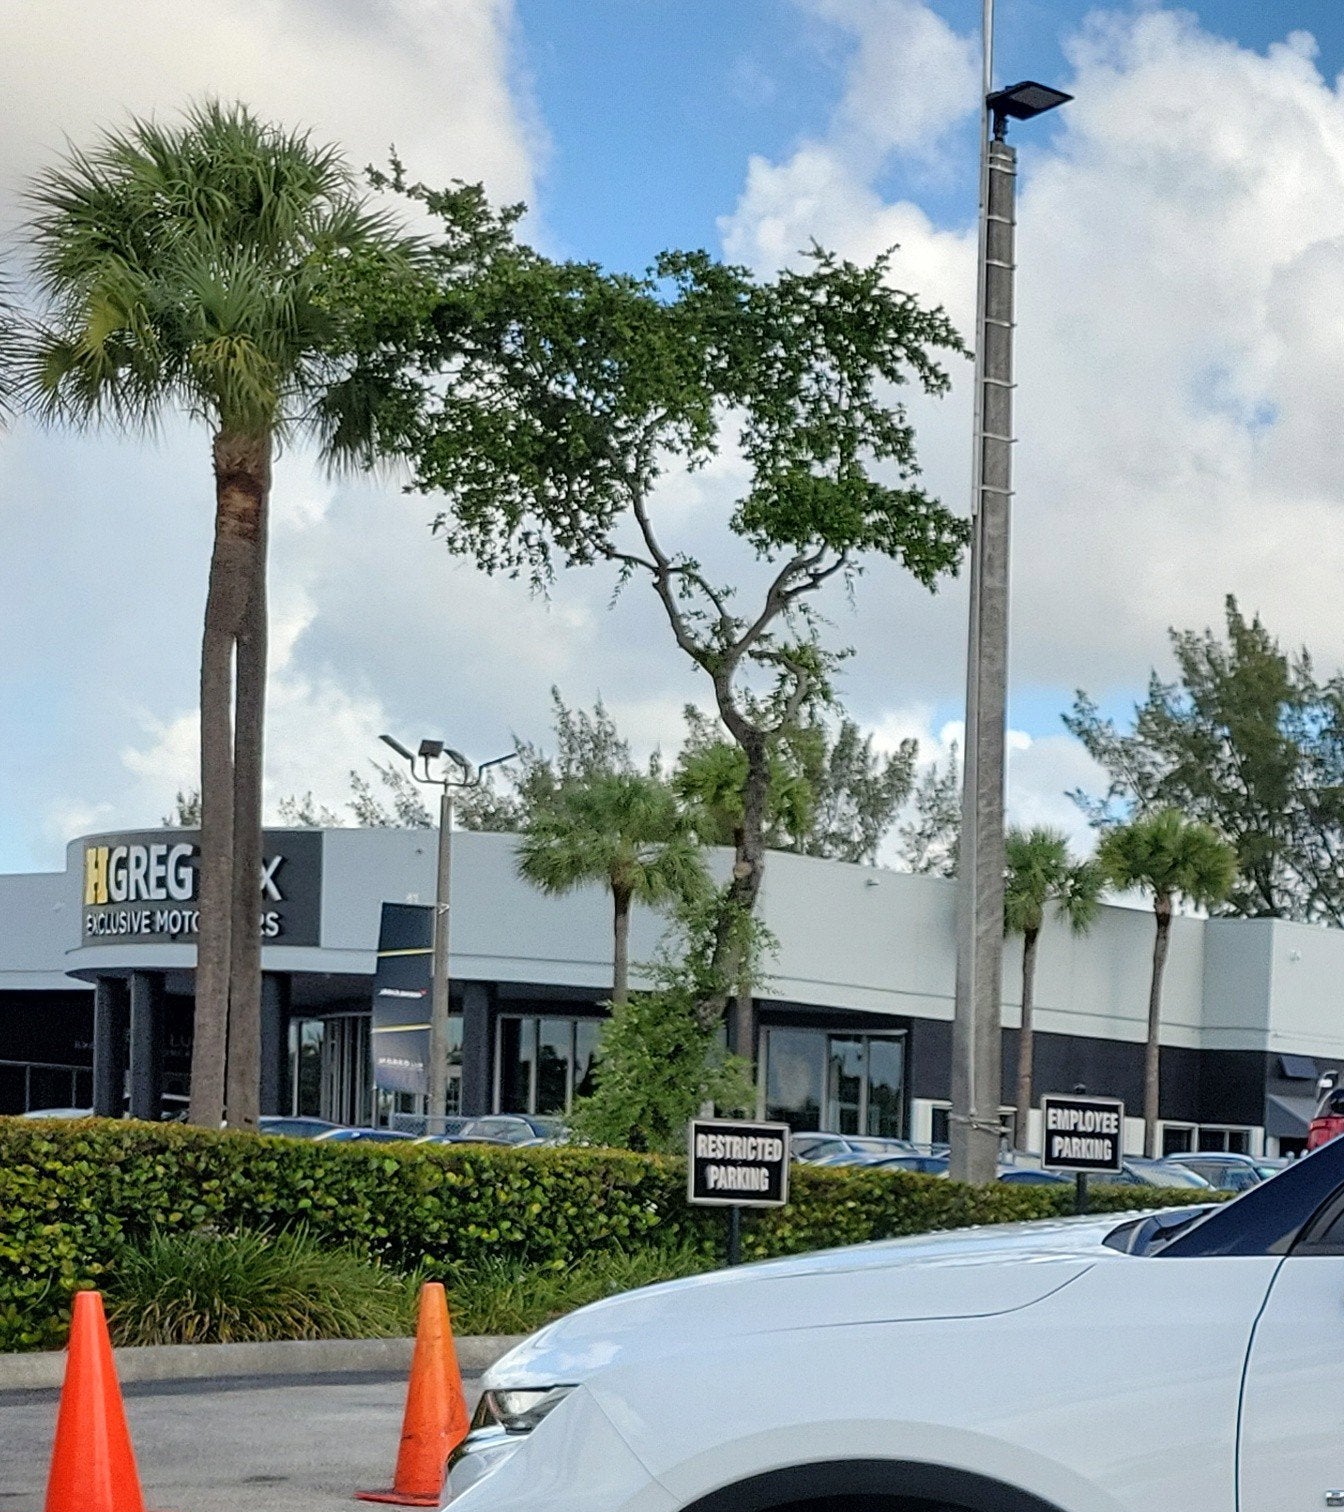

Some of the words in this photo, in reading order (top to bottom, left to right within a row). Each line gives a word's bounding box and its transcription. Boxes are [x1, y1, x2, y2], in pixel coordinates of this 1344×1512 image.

[86, 910, 151, 937] EXCLUSIVE
[1048, 1107, 1119, 1134] EMPLOYEE
[696, 1133, 782, 1162] RESTRICTED
[1052, 1135, 1112, 1161] PARKING
[705, 1164, 770, 1192] PARKING
